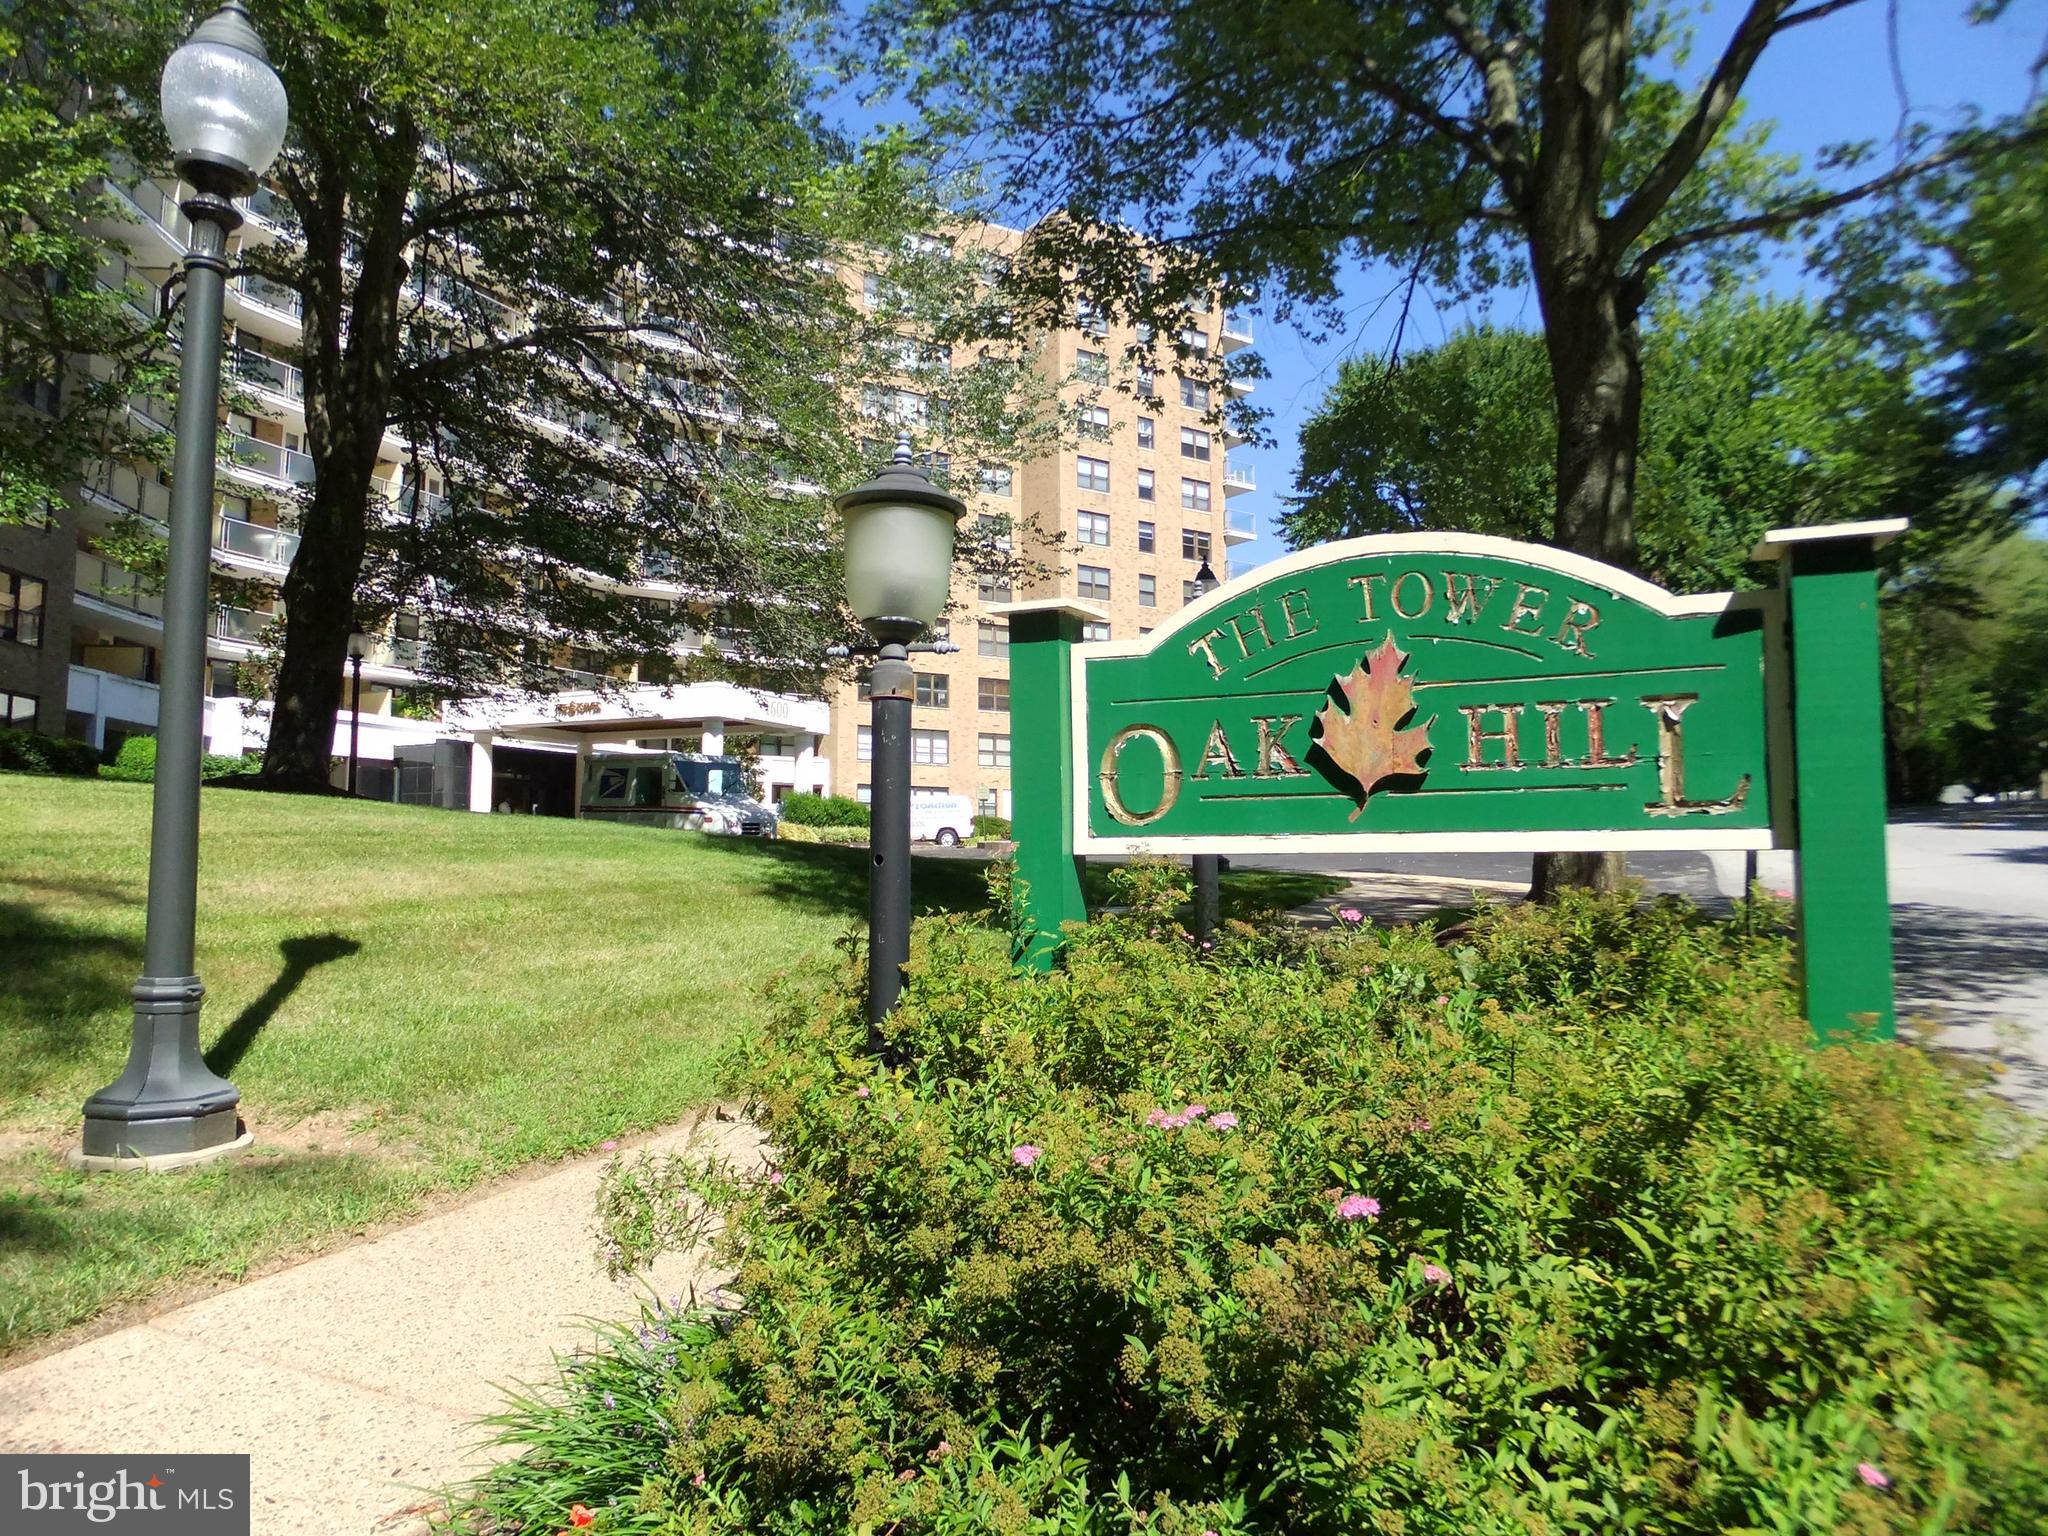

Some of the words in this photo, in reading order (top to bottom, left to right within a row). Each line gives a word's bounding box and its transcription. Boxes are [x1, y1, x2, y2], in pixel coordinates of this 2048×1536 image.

[1186, 587, 1320, 680] THE
[1347, 570, 1603, 660] TOWER
[1097, 714, 1311, 827] OAK
[1457, 693, 1752, 819] HILL
